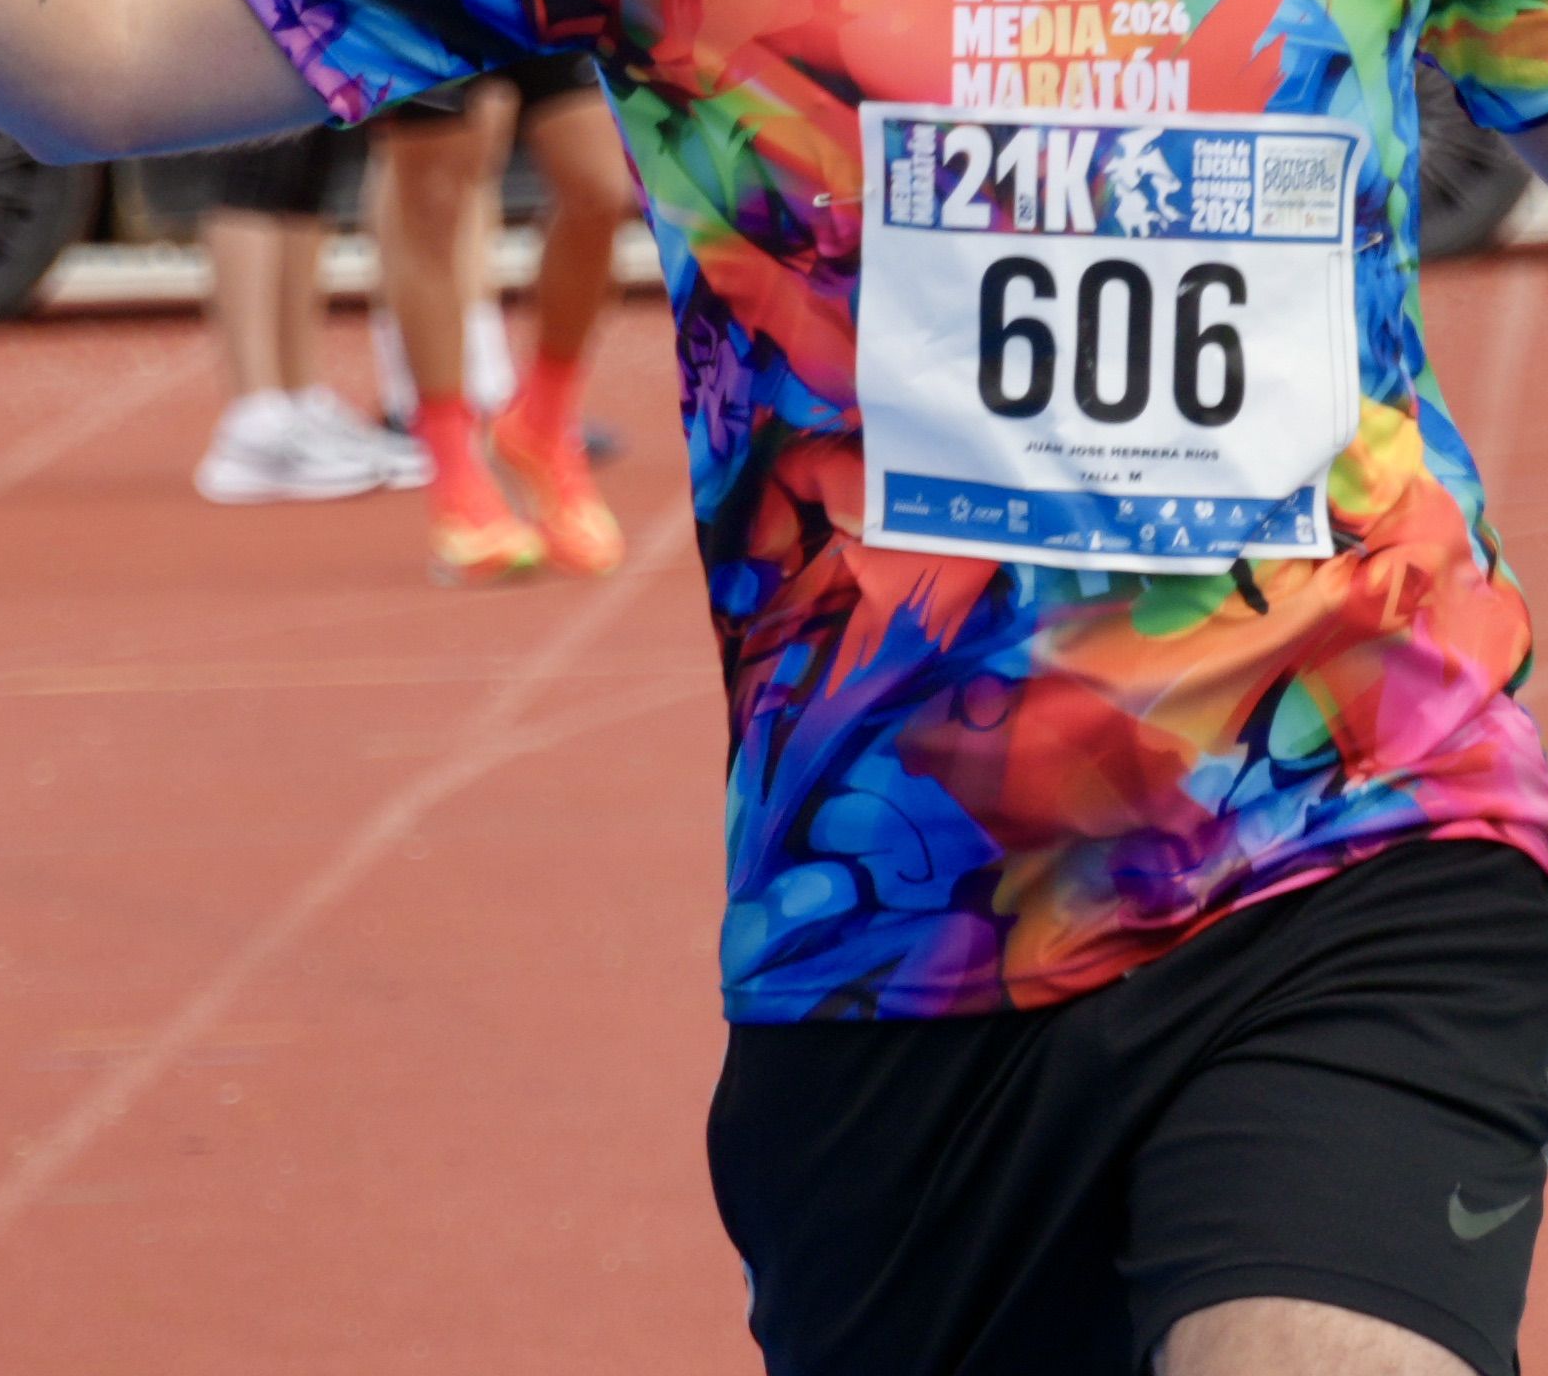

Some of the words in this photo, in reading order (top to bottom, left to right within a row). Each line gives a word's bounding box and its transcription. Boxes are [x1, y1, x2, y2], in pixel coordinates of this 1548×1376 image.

[953, 4, 1108, 58] MEDIA
[1110, 1, 1191, 36] 2026
[952, 47, 1190, 112] MARATÓN
[941, 124, 1100, 234] 21K
[1190, 199, 1251, 233] 2026
[978, 256, 1247, 428] 606
[1025, 440, 1063, 454] JUAN
[1069, 445, 1106, 458] JOSE
[1110, 447, 1179, 460] HERRERA
